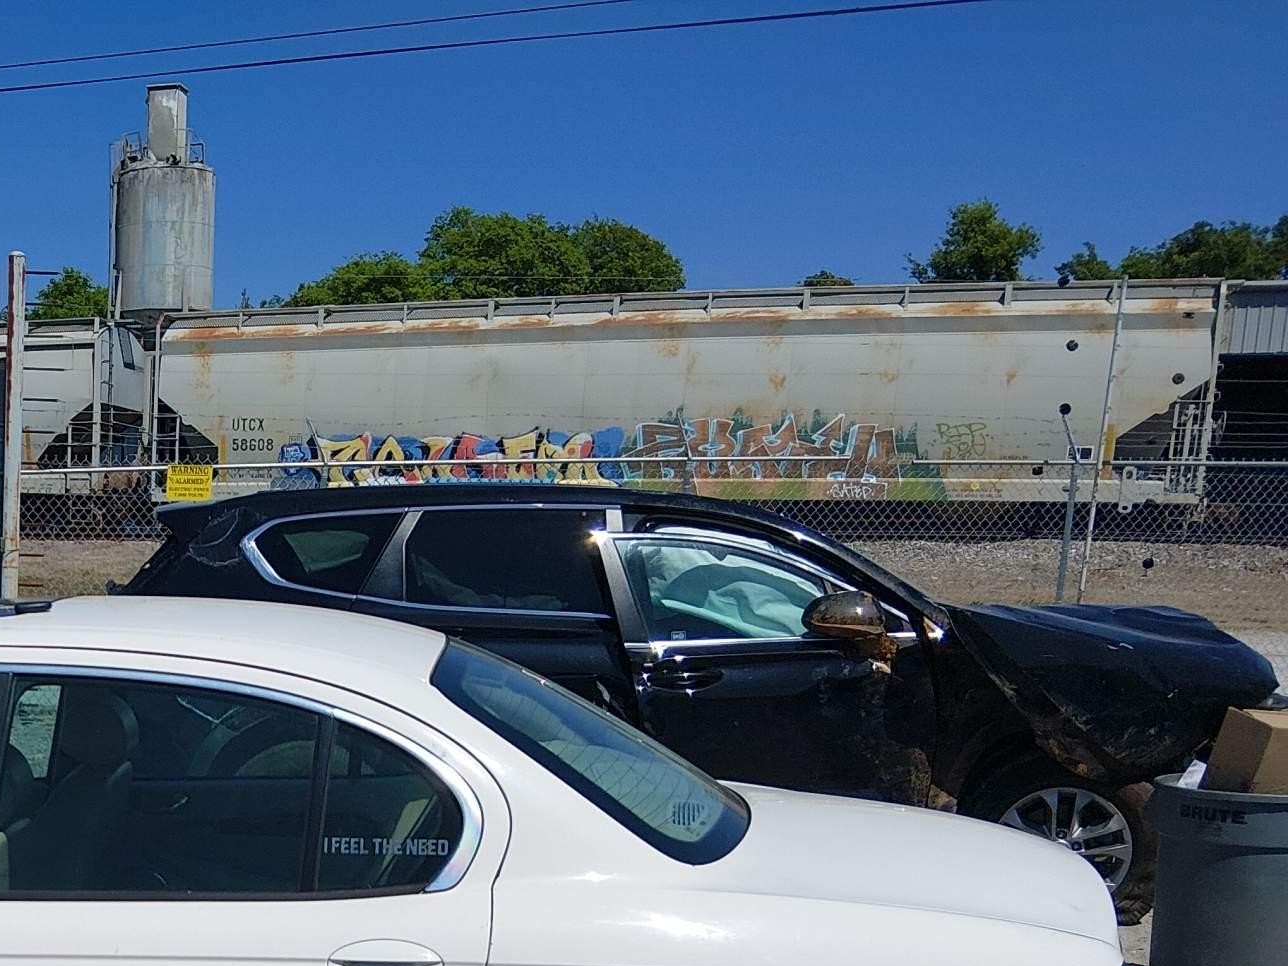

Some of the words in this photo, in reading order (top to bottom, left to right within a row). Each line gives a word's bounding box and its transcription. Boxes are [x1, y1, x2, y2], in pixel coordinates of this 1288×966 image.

[232, 417, 264, 431] UTCX
[232, 438, 274, 451] 58608
[172, 465, 209, 475] WARNING
[175, 477, 205, 485] ALARMED
[1179, 803, 1248, 825] BRUTE
[324, 836, 329, 854] I
[331, 836, 369, 855] FEEL
[373, 837, 403, 855] THE
[406, 838, 450, 856] NEED
